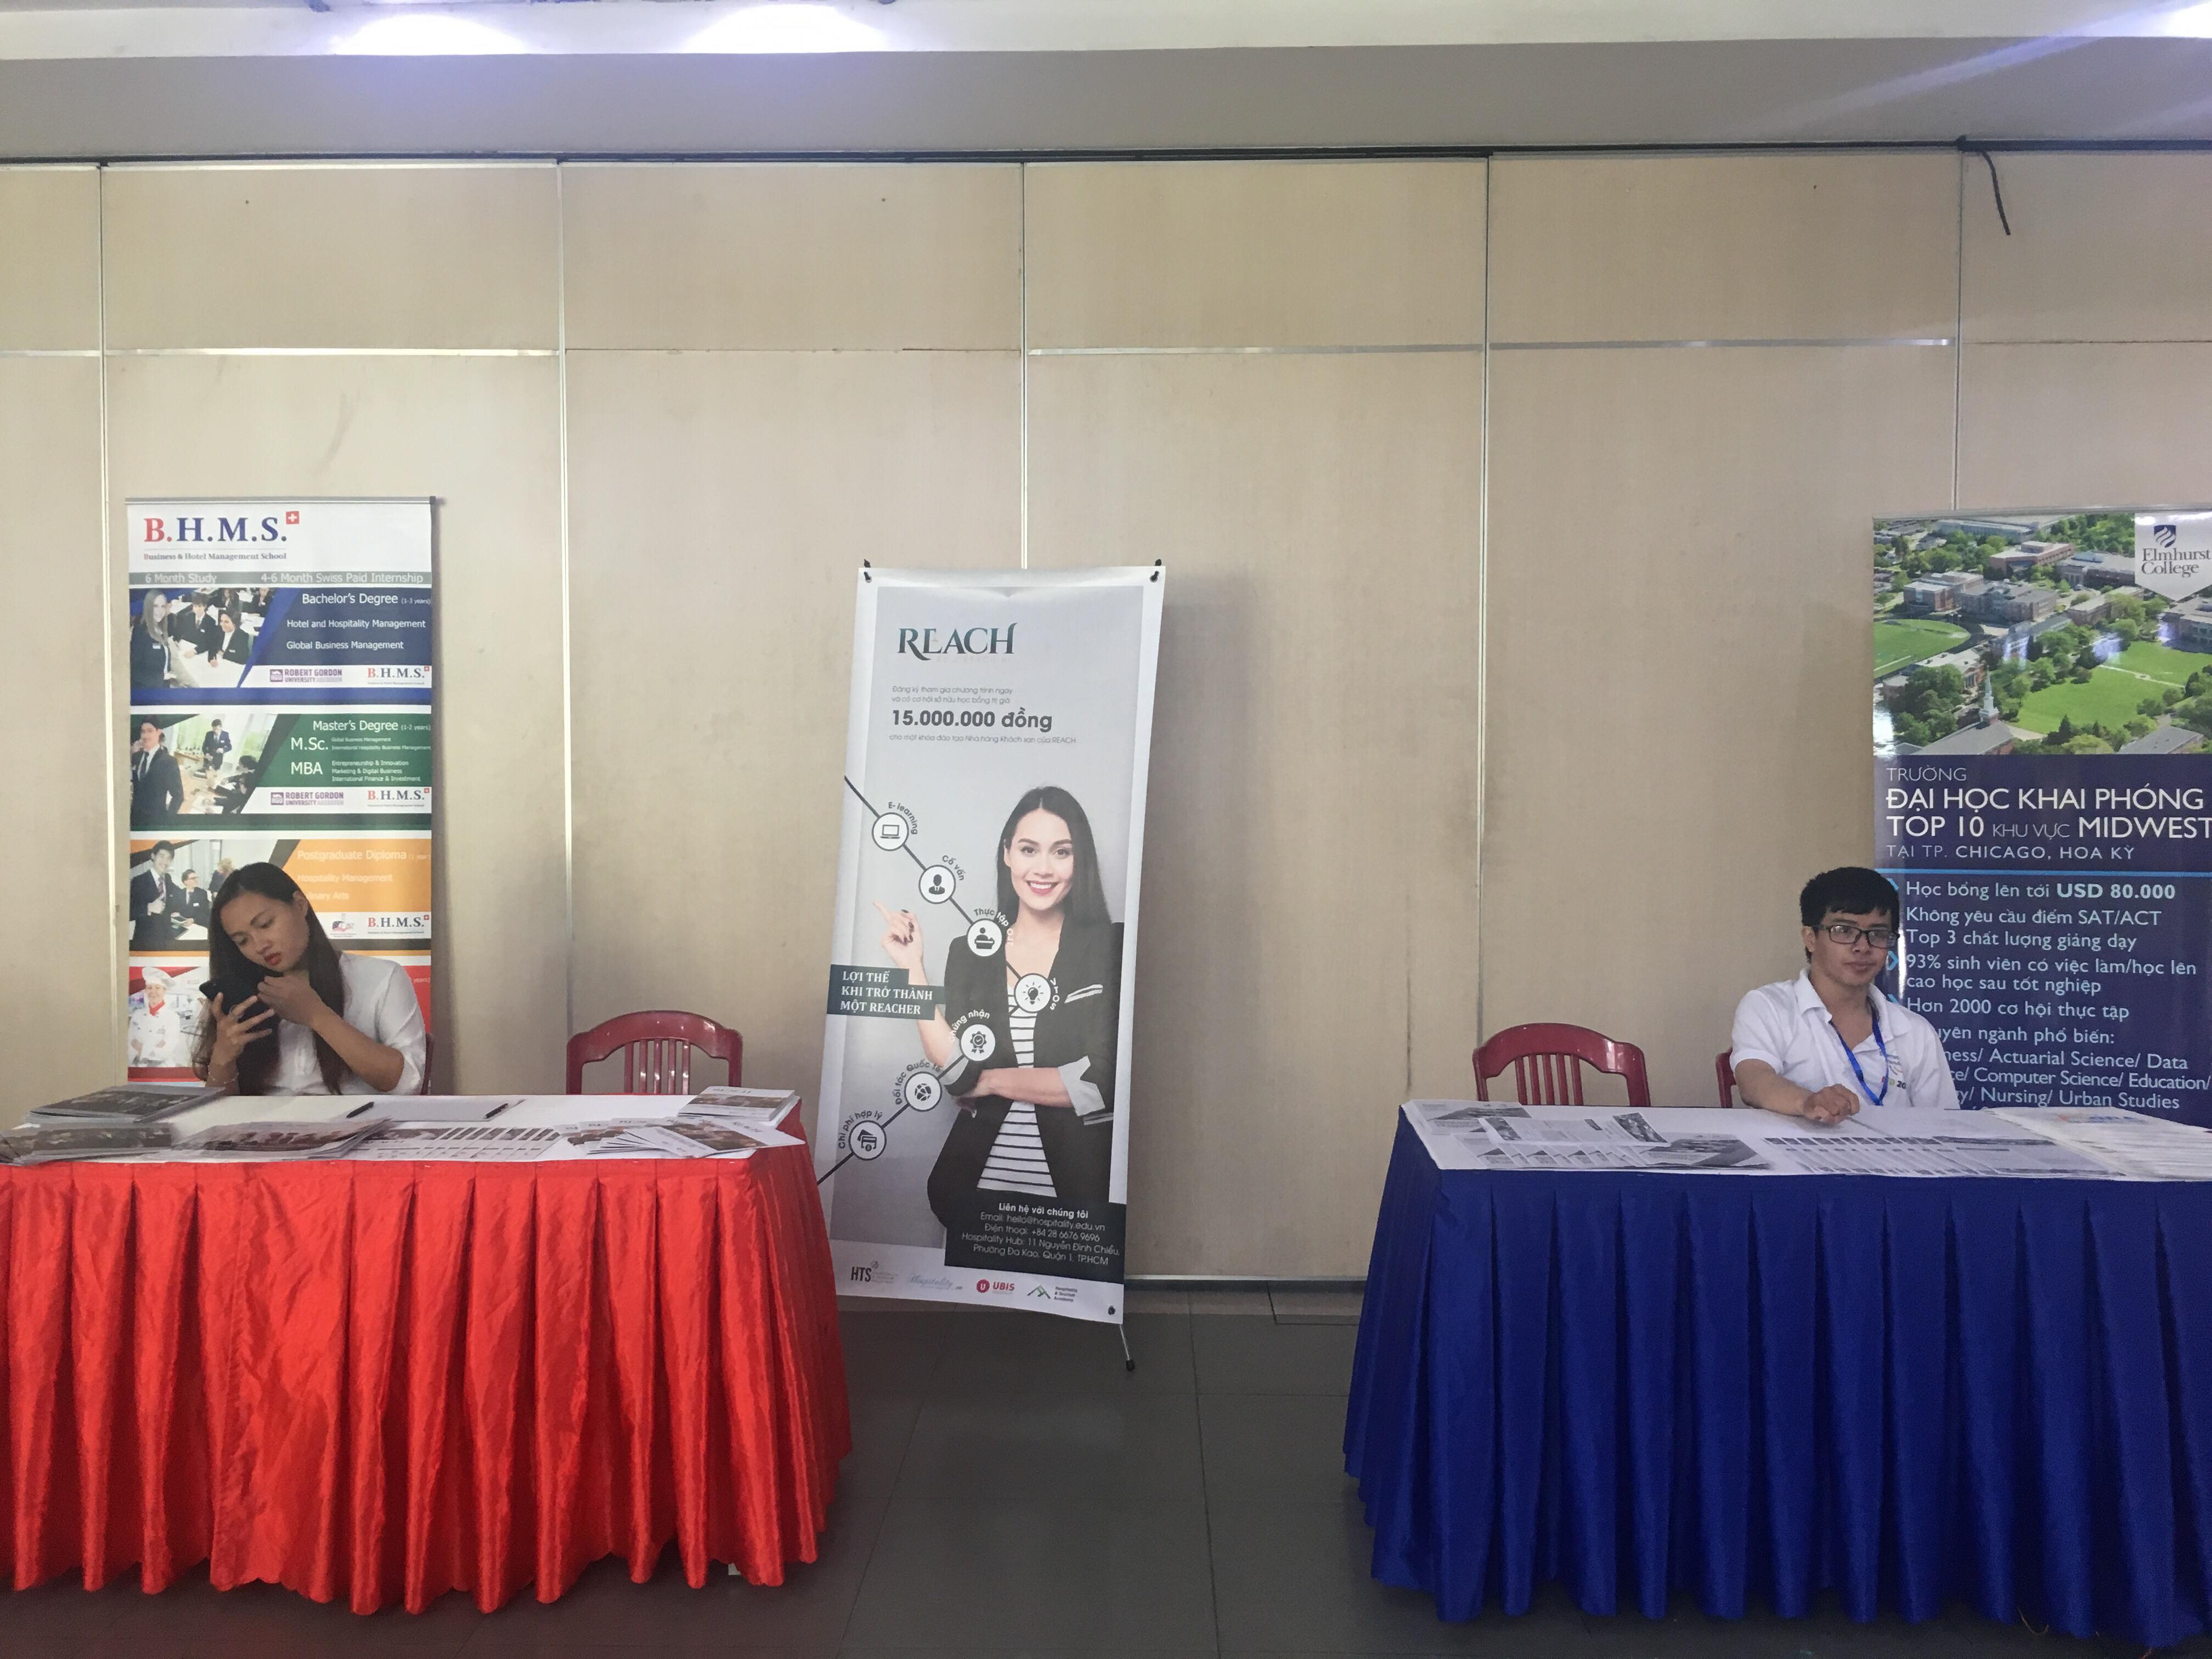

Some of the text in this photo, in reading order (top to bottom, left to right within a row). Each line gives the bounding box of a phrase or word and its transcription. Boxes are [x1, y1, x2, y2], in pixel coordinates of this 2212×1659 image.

[144, 517, 287, 542] B.H.M.S.
[2142, 548, 2211, 561] Elmhurst
[2141, 561, 2199, 578] College
[145, 573, 217, 584] 6 Month Study
[261, 573, 423, 584] 4-6 Month Swiss Paid Internship
[359, 594, 398, 605] Degree
[329, 619, 370, 629] Hospitality
[372, 620, 426, 629] Management
[351, 642, 404, 650] Management
[897, 623, 1017, 661] REACH
[368, 668, 425, 678] B.H.M.S.
[359, 720, 398, 732] Degree
[893, 707, 1052, 732] 15.000.000 đồng
[291, 737, 329, 750] M.Sc.
[291, 762, 323, 775] MBA
[1886, 765, 1967, 781] TRƯỜNG
[368, 790, 425, 800] B.H.M.S.
[1886, 783, 2204, 813] ĐẠI HỌC KHAI PHÓNG
[897, 803, 918, 834] learning
[1886, 815, 2212, 840] TOP 10 KHU VỰC MIDWEST
[298, 850, 362, 861] Postgraduate
[366, 850, 407, 861] Diploma
[1886, 844, 2135, 860] TẠI TP. CHICAGO, HOA KỲ
[942, 855, 966, 881] Cố vấn
[298, 874, 393, 883] Hospitality Management
[1906, 881, 2175, 900] Học bổng lên tới USD 80.000
[368, 917, 424, 927] B.H.M.S.
[974, 908, 1009, 927] Thực tập
[1906, 907, 2162, 928] Không yêu cầu điểm SAT/ACT
[1906, 929, 2137, 952] Top 3 chất lượng giảng dạy
[1906, 954, 2196, 976] 93% sinh viên có việc làm/học lên
[843, 970, 890, 983] LỢI THẾ
[841, 986, 933, 1000] KHI TRỞ THÀNH
[1906, 975, 2102, 996] cao học sau tốt nghiệp
[1050, 978, 1060, 1011] VTOS
[840, 999, 921, 1014] MỘT REACHER
[968, 1009, 990, 1019] nhận
[1907, 998, 2129, 1022] Hơn 2000 cơ hội thực tập
[1979, 1026, 2114, 1045] ngành phổ biến:
[1989, 1048, 2188, 1070] Actuarial Science/ Data
[1974, 1067, 2056, 1087] Computer
[2061, 1071, 2123, 1087] Science/
[2129, 1073, 2212, 1090] Education/
[1981, 1087, 2053, 1107] Nursing/
[2059, 1090, 2111, 1107] Urban
[2119, 1092, 2180, 1109] Studies
[854, 1110, 872, 1119] hợp
[998, 1203, 1016, 1212] Liên
[1018, 1204, 1029, 1215] hệ
[1047, 1207, 1075, 1220] chúng
[1076, 1210, 1089, 1218] tôi
[962, 1233, 1004, 1244] Hospitality
[1059, 1231, 1078, 1240] 6676
[1080, 1233, 1100, 1243] 9696
[1043, 1251, 1066, 1261] Quận
[850, 1266, 872, 1282] HTS
[992, 1282, 1015, 1291] UBIS
